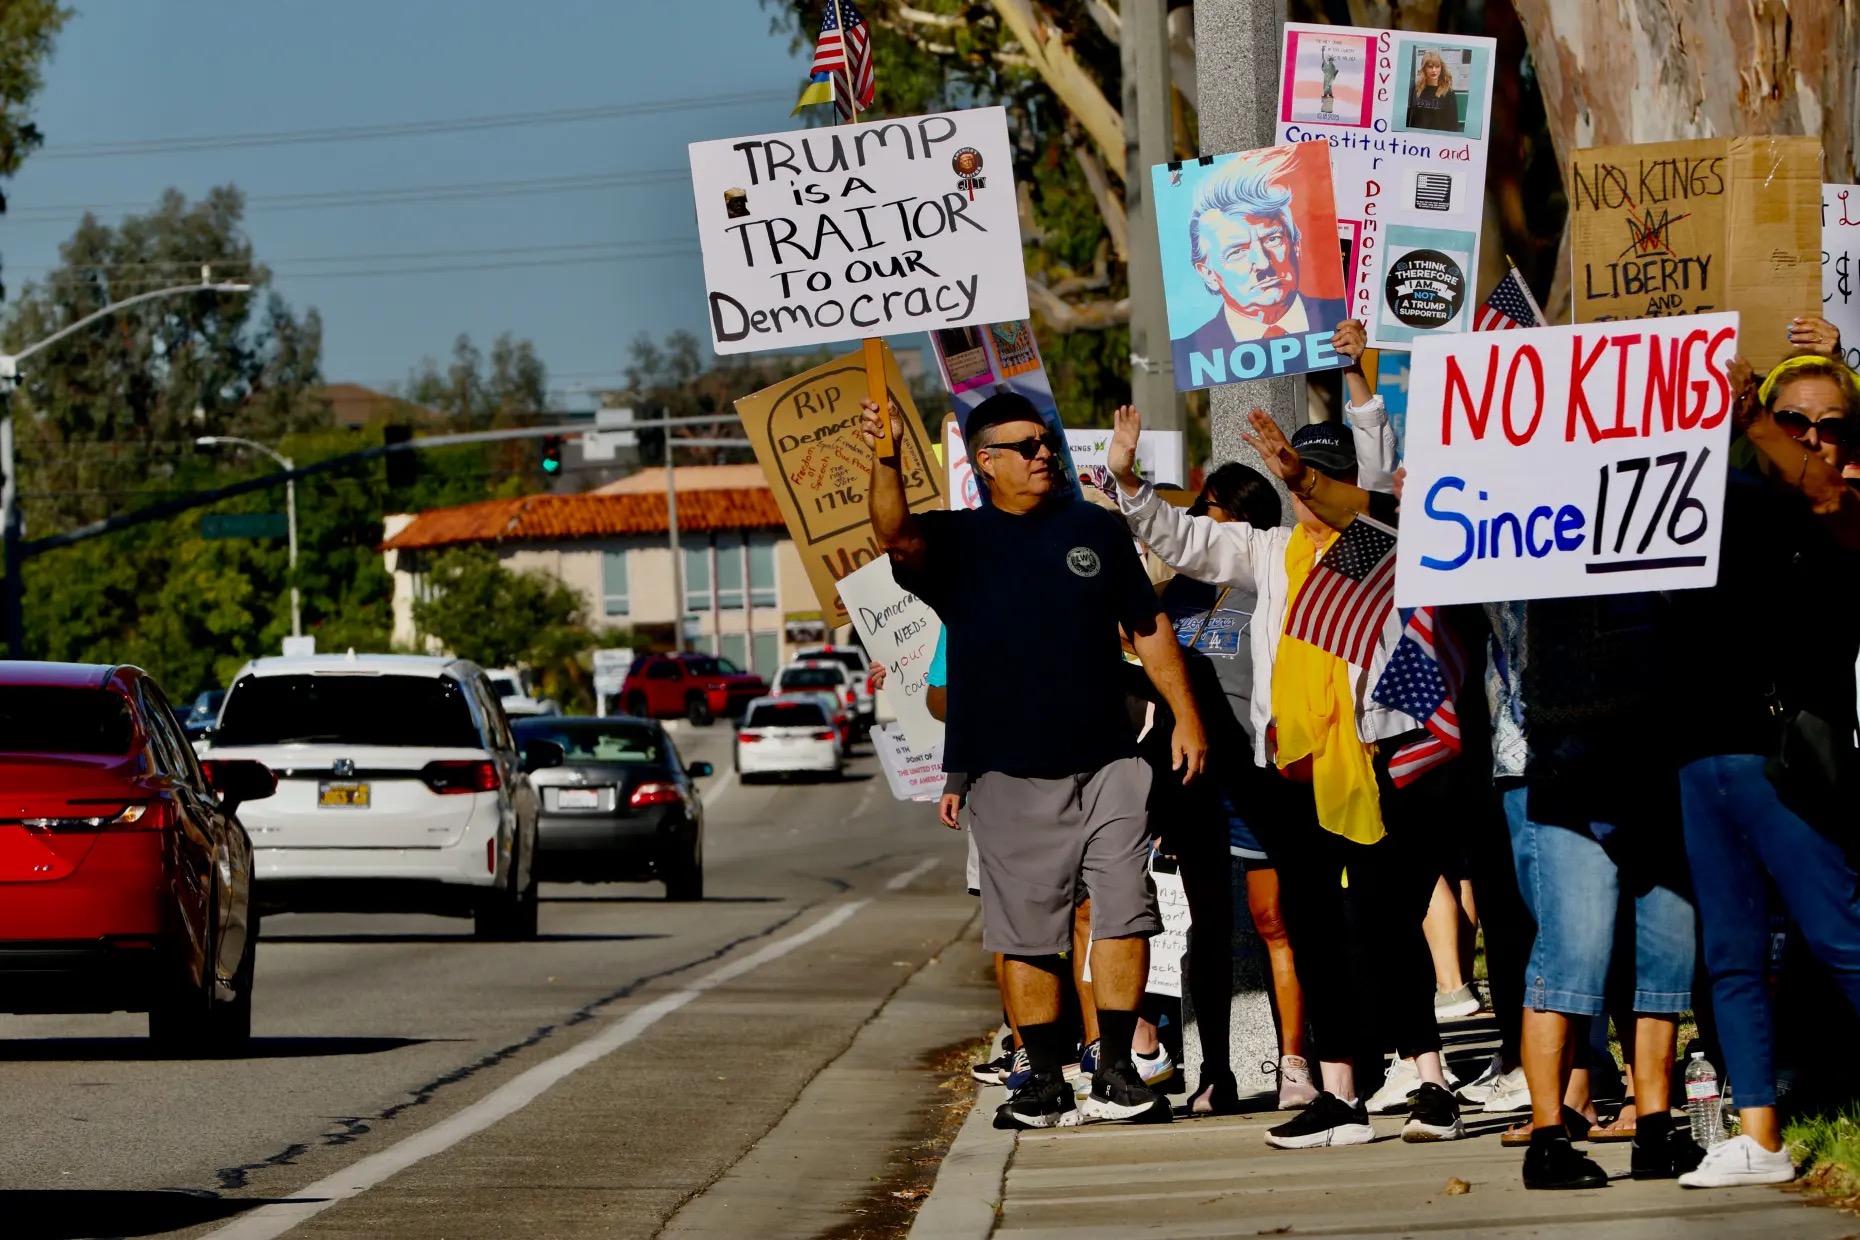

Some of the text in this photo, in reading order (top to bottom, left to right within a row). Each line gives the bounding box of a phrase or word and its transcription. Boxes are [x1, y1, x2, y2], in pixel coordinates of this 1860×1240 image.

[1376, 31, 1391, 102] Save
[1438, 145, 1472, 162] and
[840, 177, 876, 198] A
[1573, 157, 1725, 212] NO KINGS
[725, 192, 988, 267] TRAITOR
[770, 250, 941, 298] TO OUR
[1395, 269, 1459, 286] THEREFORE
[1409, 260, 1447, 272] I THINK
[1585, 254, 1713, 301] LIBERTY
[709, 274, 978, 342] Democracy
[1402, 299, 1446, 311] A TRUMP
[1414, 291, 1436, 300] NOT
[1647, 294, 1683, 315] AND
[1399, 308, 1447, 319] SUPPORTER
[1189, 330, 1339, 387] NOPE
[1442, 326, 1736, 447] NO KINGS
[1420, 446, 1711, 571] Since 1776
[893, 617, 927, 647] NEEDS
[890, 643, 926, 684] your
[906, 755, 924, 763] POINT
